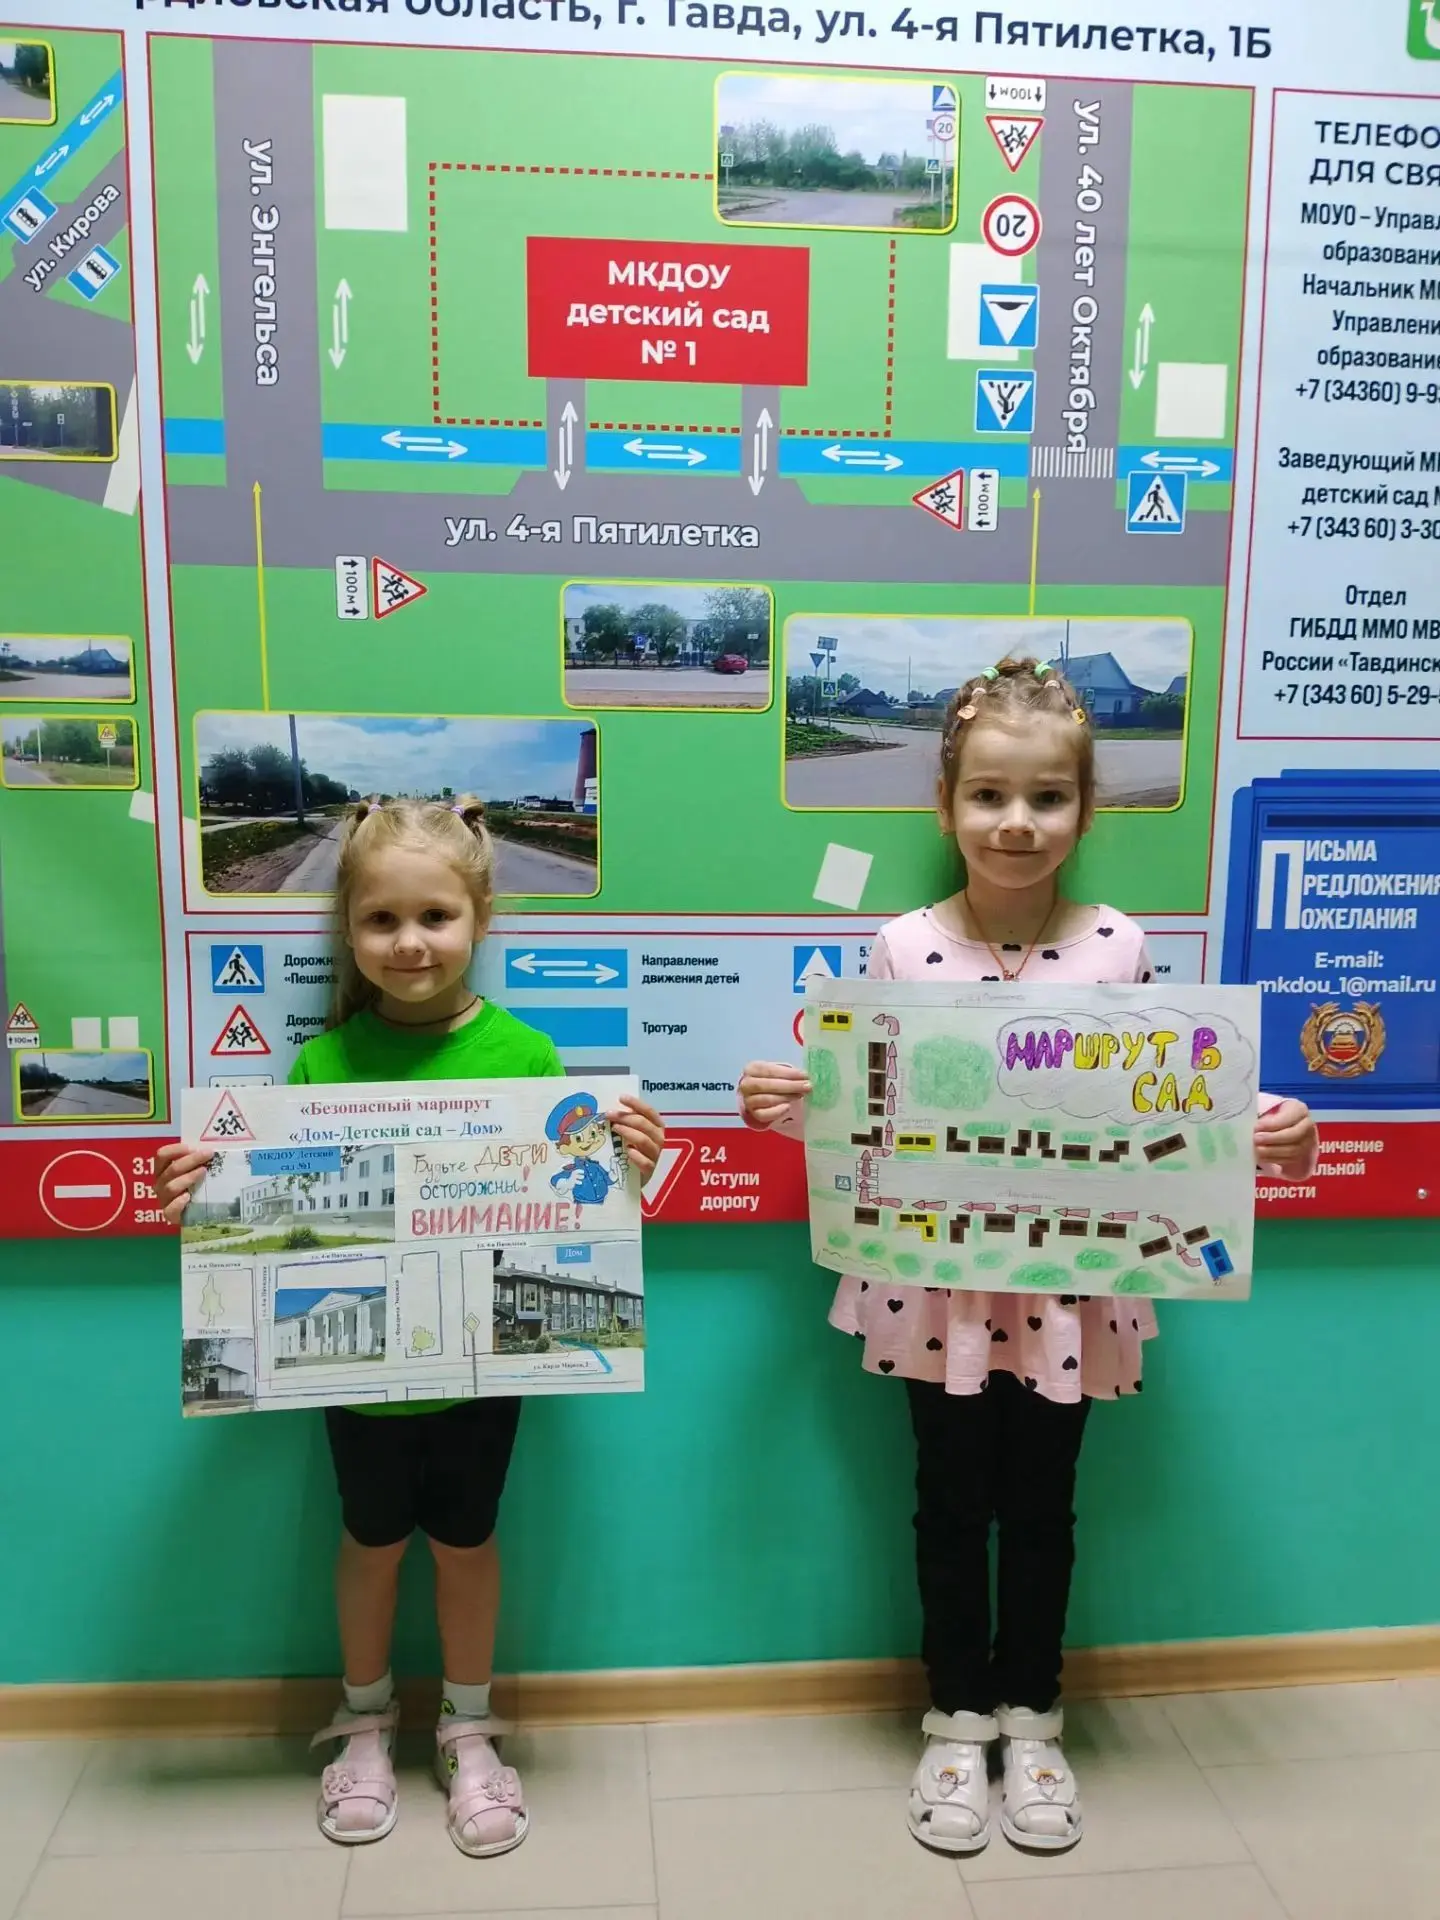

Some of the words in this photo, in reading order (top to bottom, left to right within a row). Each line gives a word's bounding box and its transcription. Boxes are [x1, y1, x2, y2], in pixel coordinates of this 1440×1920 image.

[815, 10, 878, 43] ул.
[891, 7, 959, 42] 4-я
[975, 13, 1215, 62] Пятилетка,
[1228, 26, 1272, 60] 1Б
[938, 122, 953, 134] 20
[1073, 99, 1101, 155] ул.
[242, 137, 273, 196] ул.
[1310, 158, 1375, 187] ДЛЯ
[1385, 161, 1440, 187] СВЯ
[1076, 164, 1104, 213] 40
[996, 214, 1027, 238] 20
[1301, 203, 1356, 225] МОУО
[22, 256, 56, 292] ул.
[48, 183, 121, 259] Кирова
[1073, 220, 1097, 287] лет
[607, 260, 731, 292] МКДОУ
[1303, 274, 1414, 299] Начальник
[251, 204, 281, 386] Энгельса
[566, 301, 703, 327] детский
[712, 309, 770, 333] сад
[641, 339, 677, 365] №
[685, 341, 697, 366] 1
[1062, 295, 1099, 454] Октября
[1296, 379, 1320, 401] +7
[1324, 379, 1400, 405] (34360)
[1406, 382, 1440, 404] 9-9
[1279, 447, 1415, 474] Заведующий
[1302, 485, 1388, 506] детский
[1393, 489, 1429, 508] сад
[444, 516, 497, 546] ул.
[505, 514, 562, 543] 4-я
[572, 515, 760, 549] Пятилетка
[1287, 517, 1311, 537] +7
[1316, 517, 1359, 540] (343
[1364, 518, 1396, 541] 60)
[1346, 584, 1407, 607] Отдел
[1290, 617, 1357, 640] ГИБДД
[1362, 618, 1408, 640] ММО
[1412, 618, 1440, 640] МВ
[1262, 651, 1333, 671] России
[1274, 684, 1298, 704] +7
[1303, 684, 1346, 707] (343
[1350, 684, 1382, 707] 60)
[1387, 685, 1440, 706] 5-29-
[641, 954, 719, 969] Направление
[1314, 952, 1384, 969] E-mail:
[641, 972, 703, 985] движения
[704, 971, 740, 985] детей
[1257, 976, 1437, 997] mkdou_1@mail.ru
[642, 1021, 688, 1035] Тротуар
[1006, 1029, 1179, 1071] МАРШРУТ
[1191, 1027, 1222, 1071] В
[641, 1079, 700, 1093] Проезжая
[701, 1080, 735, 1092] часть
[1132, 1071, 1213, 1113] САД
[300, 1099, 411, 1117] «Безопасный
[417, 1098, 492, 1114] маршрут
[289, 1123, 410, 1143] «Дом-Детский
[416, 1124, 441, 1137] сад
[459, 1121, 503, 1137] Дом»
[473, 1142, 548, 1174] ДЕТИ
[700, 1146, 727, 1163] 2.4
[700, 1170, 760, 1187] Уступи
[700, 1193, 760, 1212] дорогу
[411, 1201, 583, 1236] ВНИМАНИЕ!
[565, 1248, 583, 1258] Дом
